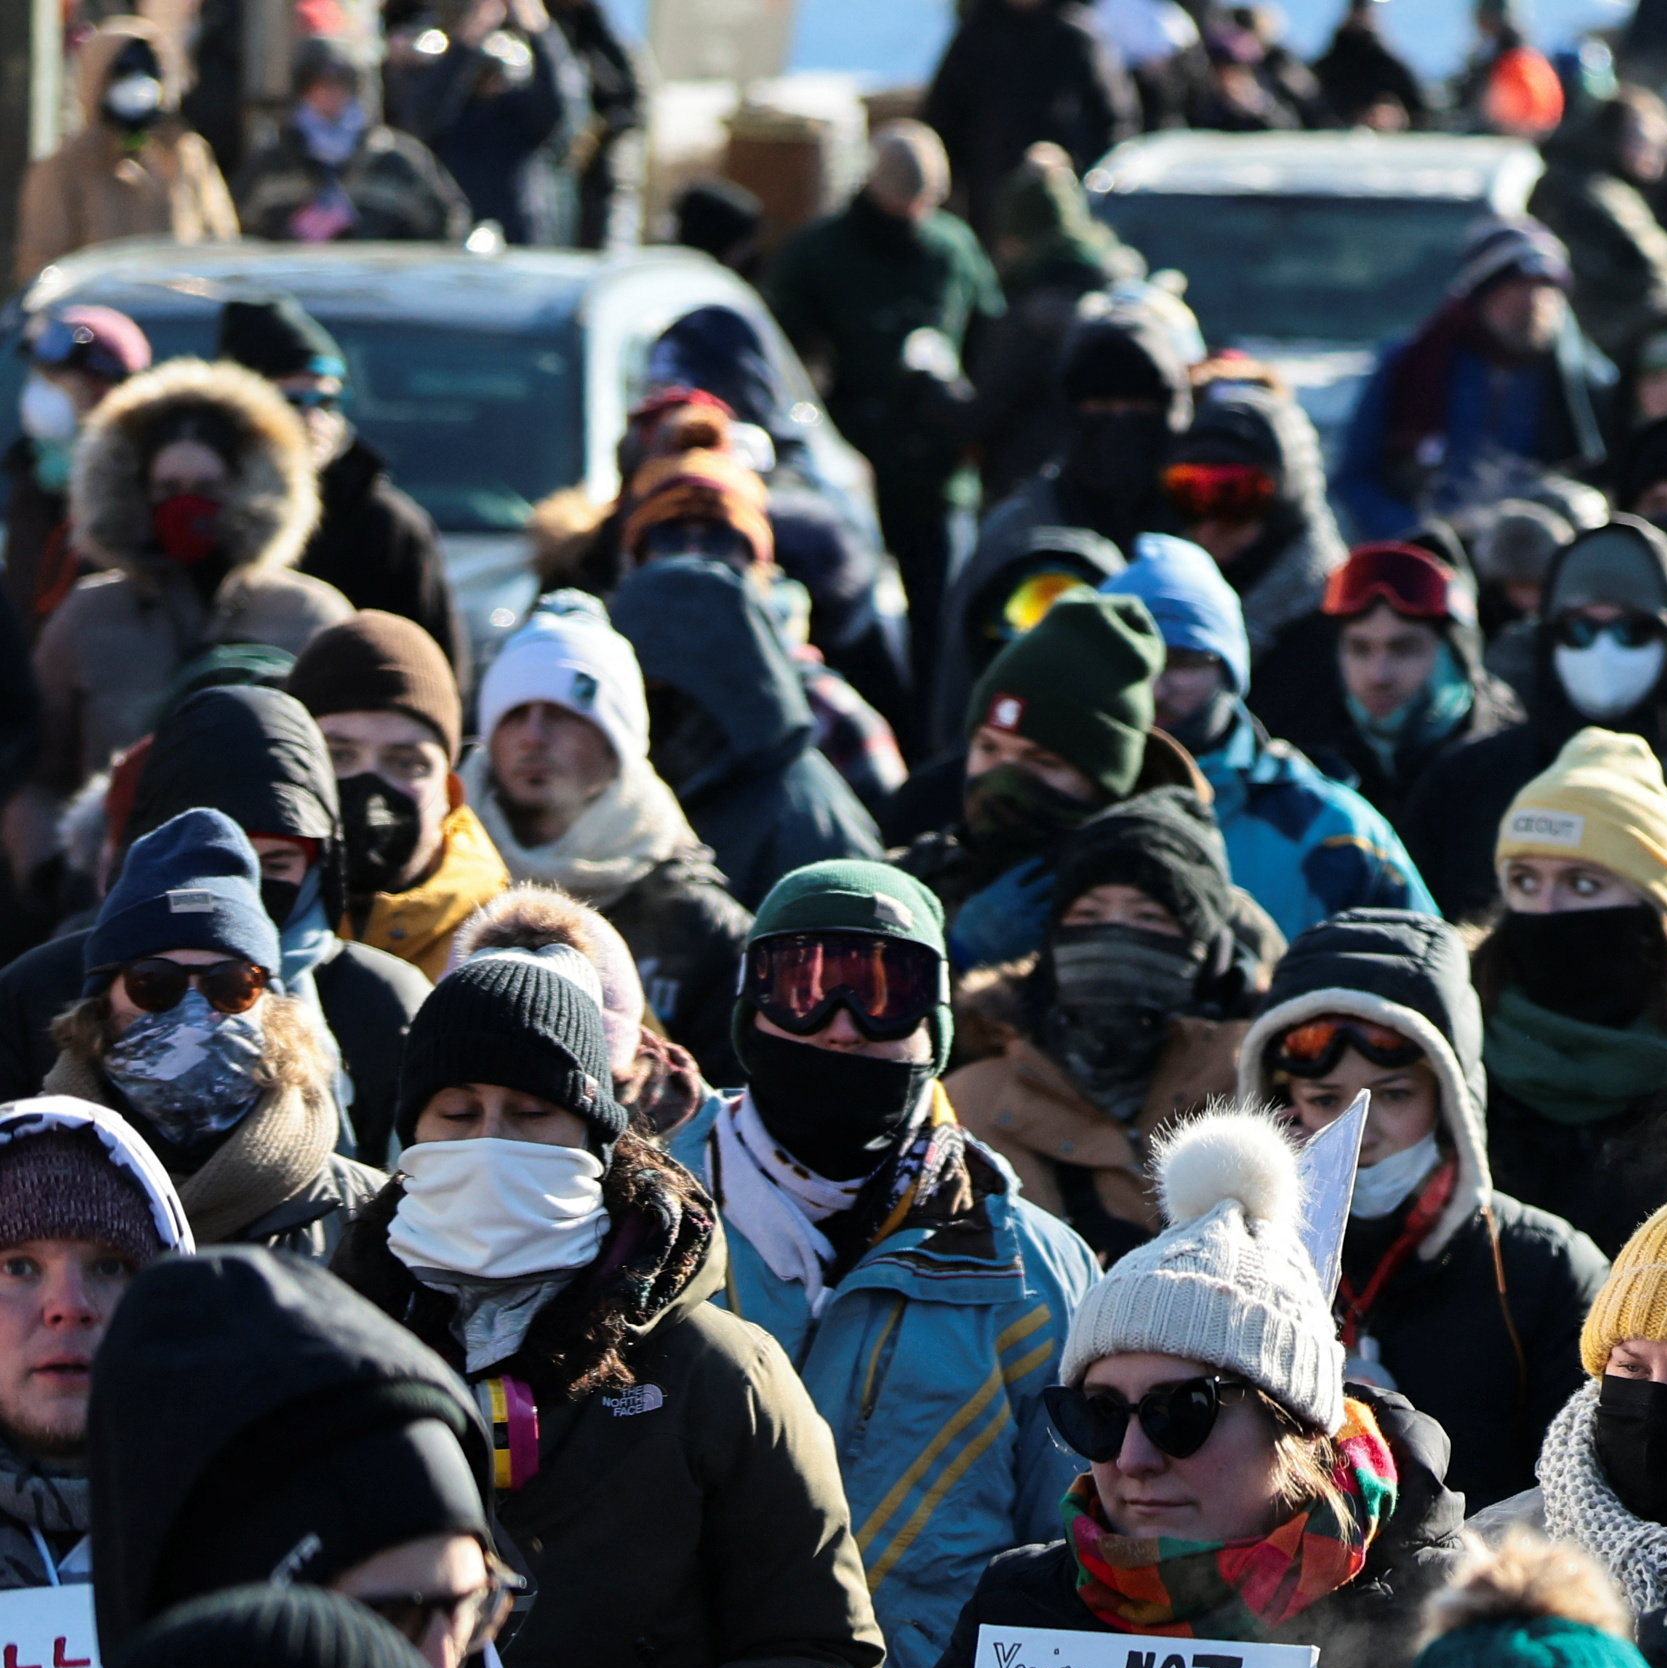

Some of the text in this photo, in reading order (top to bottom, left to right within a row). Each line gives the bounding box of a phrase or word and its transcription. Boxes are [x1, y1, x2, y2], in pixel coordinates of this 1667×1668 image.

[620, 1386, 644, 1397] THE
[602, 1395, 643, 1408] NORTH
[613, 1404, 644, 1417] FACE
